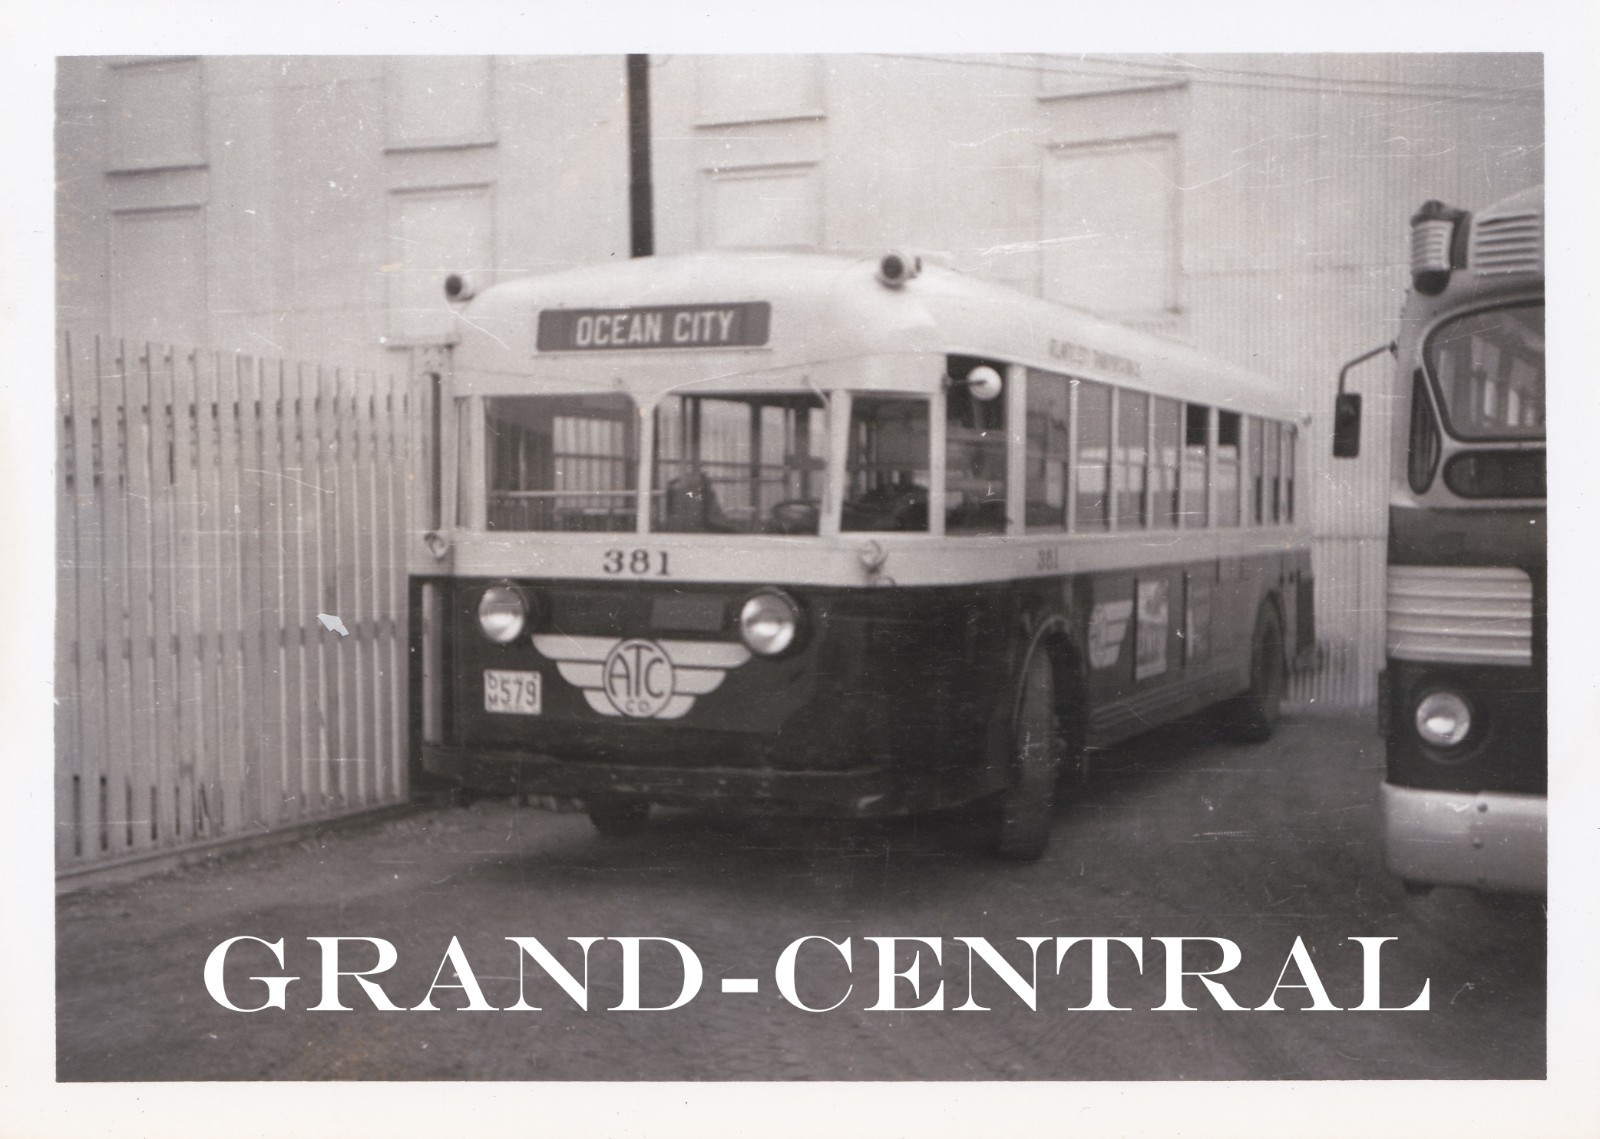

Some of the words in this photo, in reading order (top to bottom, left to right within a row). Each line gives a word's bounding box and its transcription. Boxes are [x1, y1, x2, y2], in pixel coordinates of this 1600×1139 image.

[575, 312, 662, 347] OCEAN
[672, 309, 735, 343] CITY
[603, 550, 671, 576] 381
[608, 643, 665, 698] ATC
[500, 678, 537, 706] 579
